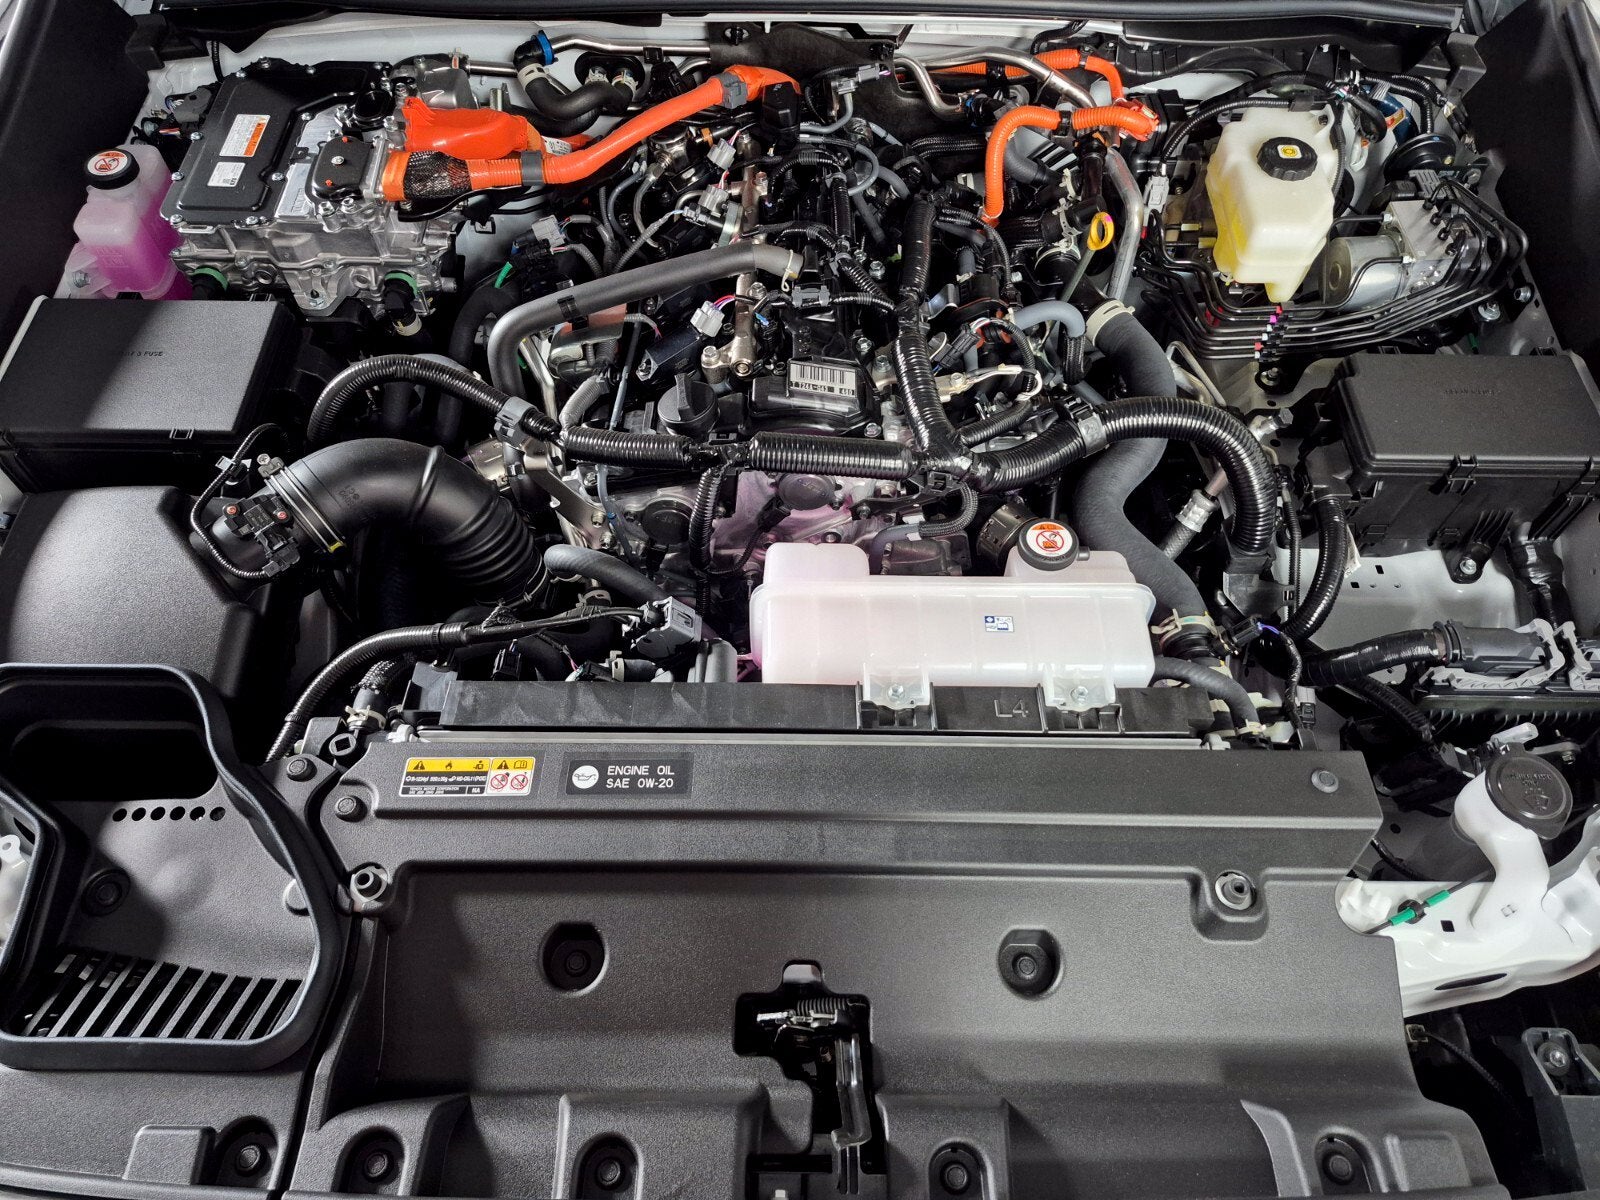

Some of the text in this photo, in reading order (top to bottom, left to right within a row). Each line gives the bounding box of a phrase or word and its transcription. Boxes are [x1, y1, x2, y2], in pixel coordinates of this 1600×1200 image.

[994, 699, 1029, 718] L4
[607, 765, 675, 775] ENGINE OIL
[606, 778, 674, 788] SAE 0W-20
